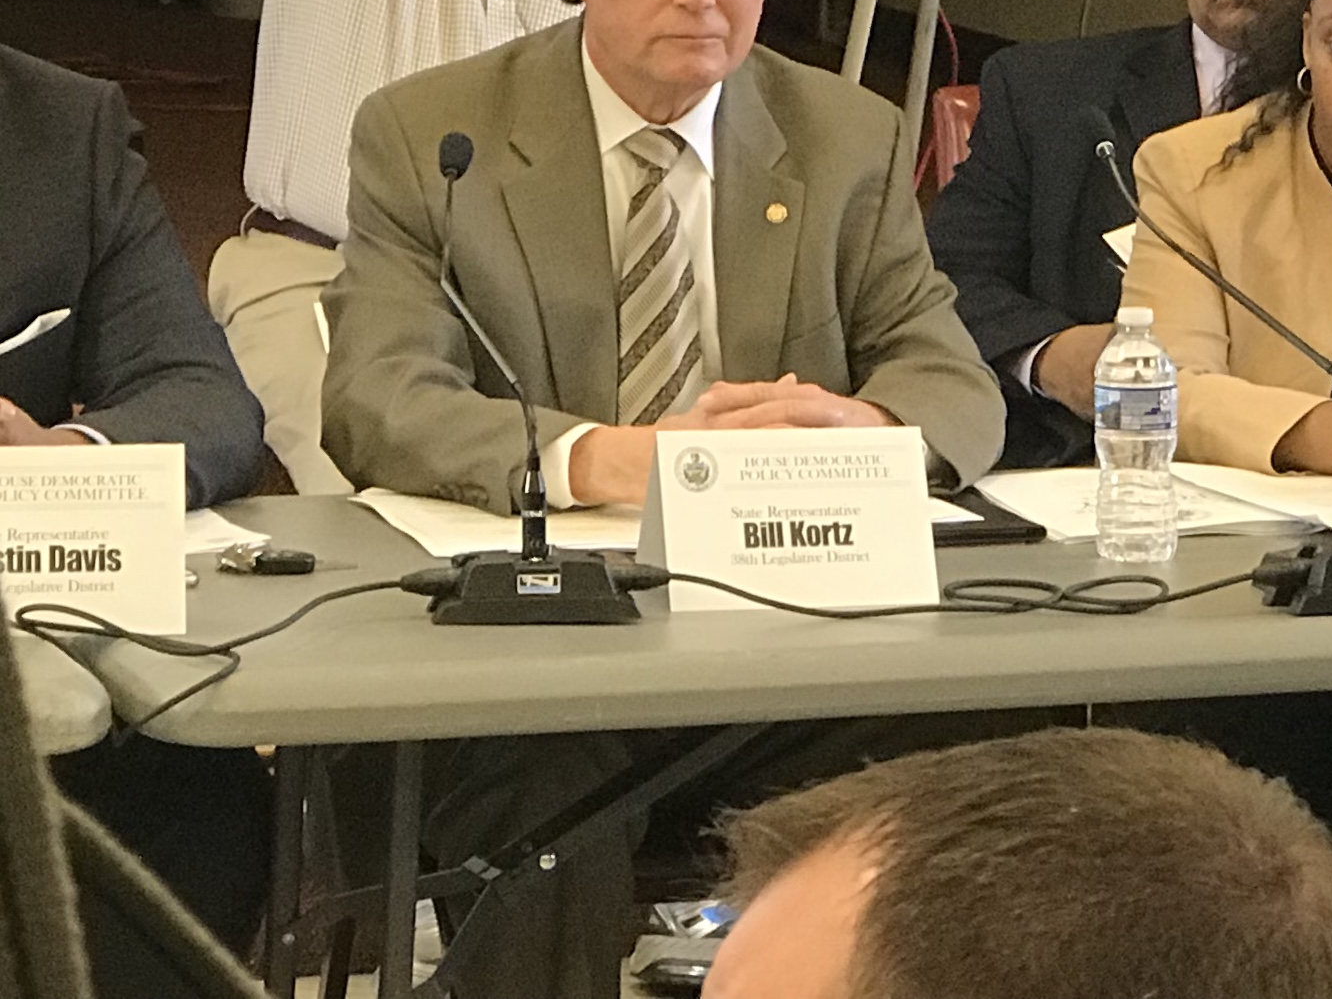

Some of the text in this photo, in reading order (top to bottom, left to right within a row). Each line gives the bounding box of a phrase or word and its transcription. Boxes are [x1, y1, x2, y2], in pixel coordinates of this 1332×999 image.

[744, 455, 884, 468] HOUSE DEMOCRATIC
[41, 475, 140, 486] DEMOCRATIC
[740, 467, 890, 481] POLICY COMMITTEE
[0, 488, 147, 502] LICY COMMITTEE
[731, 505, 861, 520] State Representative
[7, 528, 109, 543] Representative
[743, 520, 854, 548] Bill Kortz
[48, 543, 122, 573] Davis
[762, 552, 823, 566] Legislative
[827, 549, 870, 563] District
[3, 579, 115, 595] egislative District
